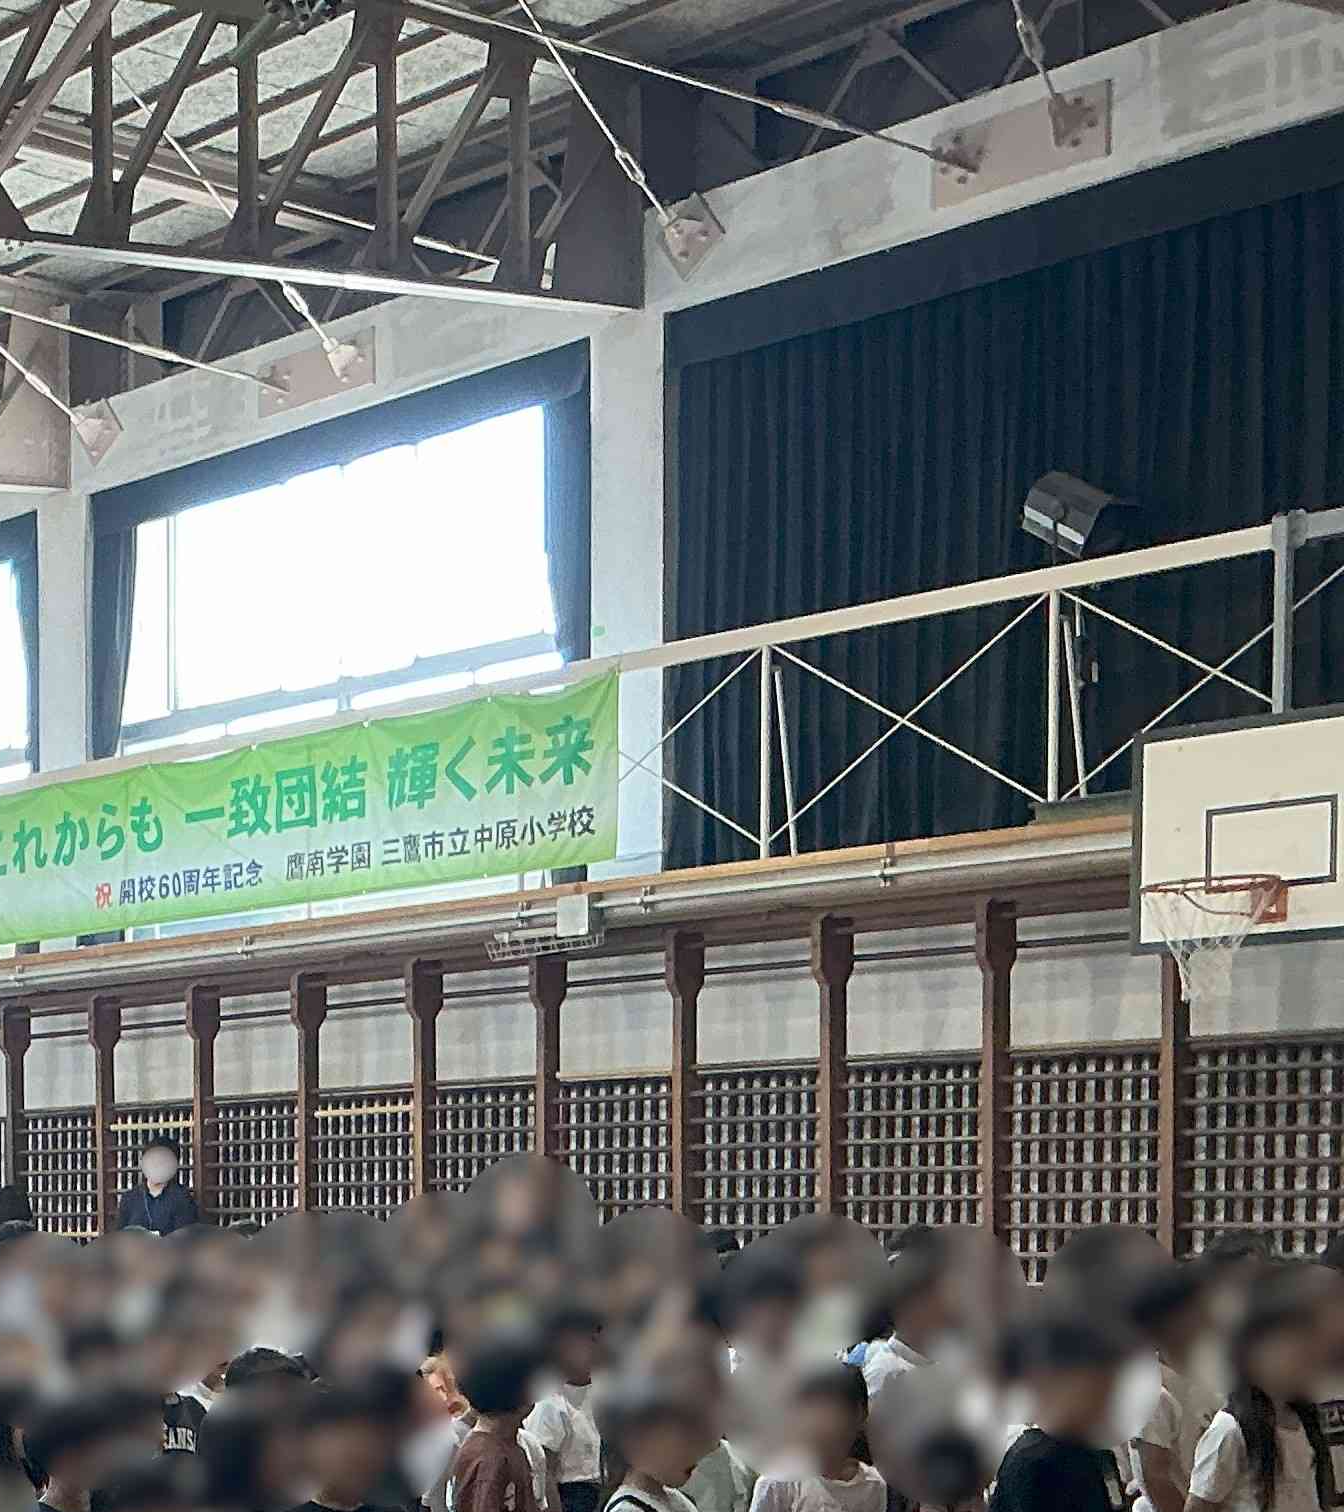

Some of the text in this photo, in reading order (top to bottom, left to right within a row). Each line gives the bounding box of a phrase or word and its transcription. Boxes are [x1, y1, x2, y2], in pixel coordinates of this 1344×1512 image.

[184, 754, 369, 840] 一致団結
[387, 714, 595, 811] 輝く未来
[95, 882, 113, 908] 祝
[118, 858, 264, 906] 開校60周年記念
[381, 804, 596, 867] 三鷹市立中原小学校
